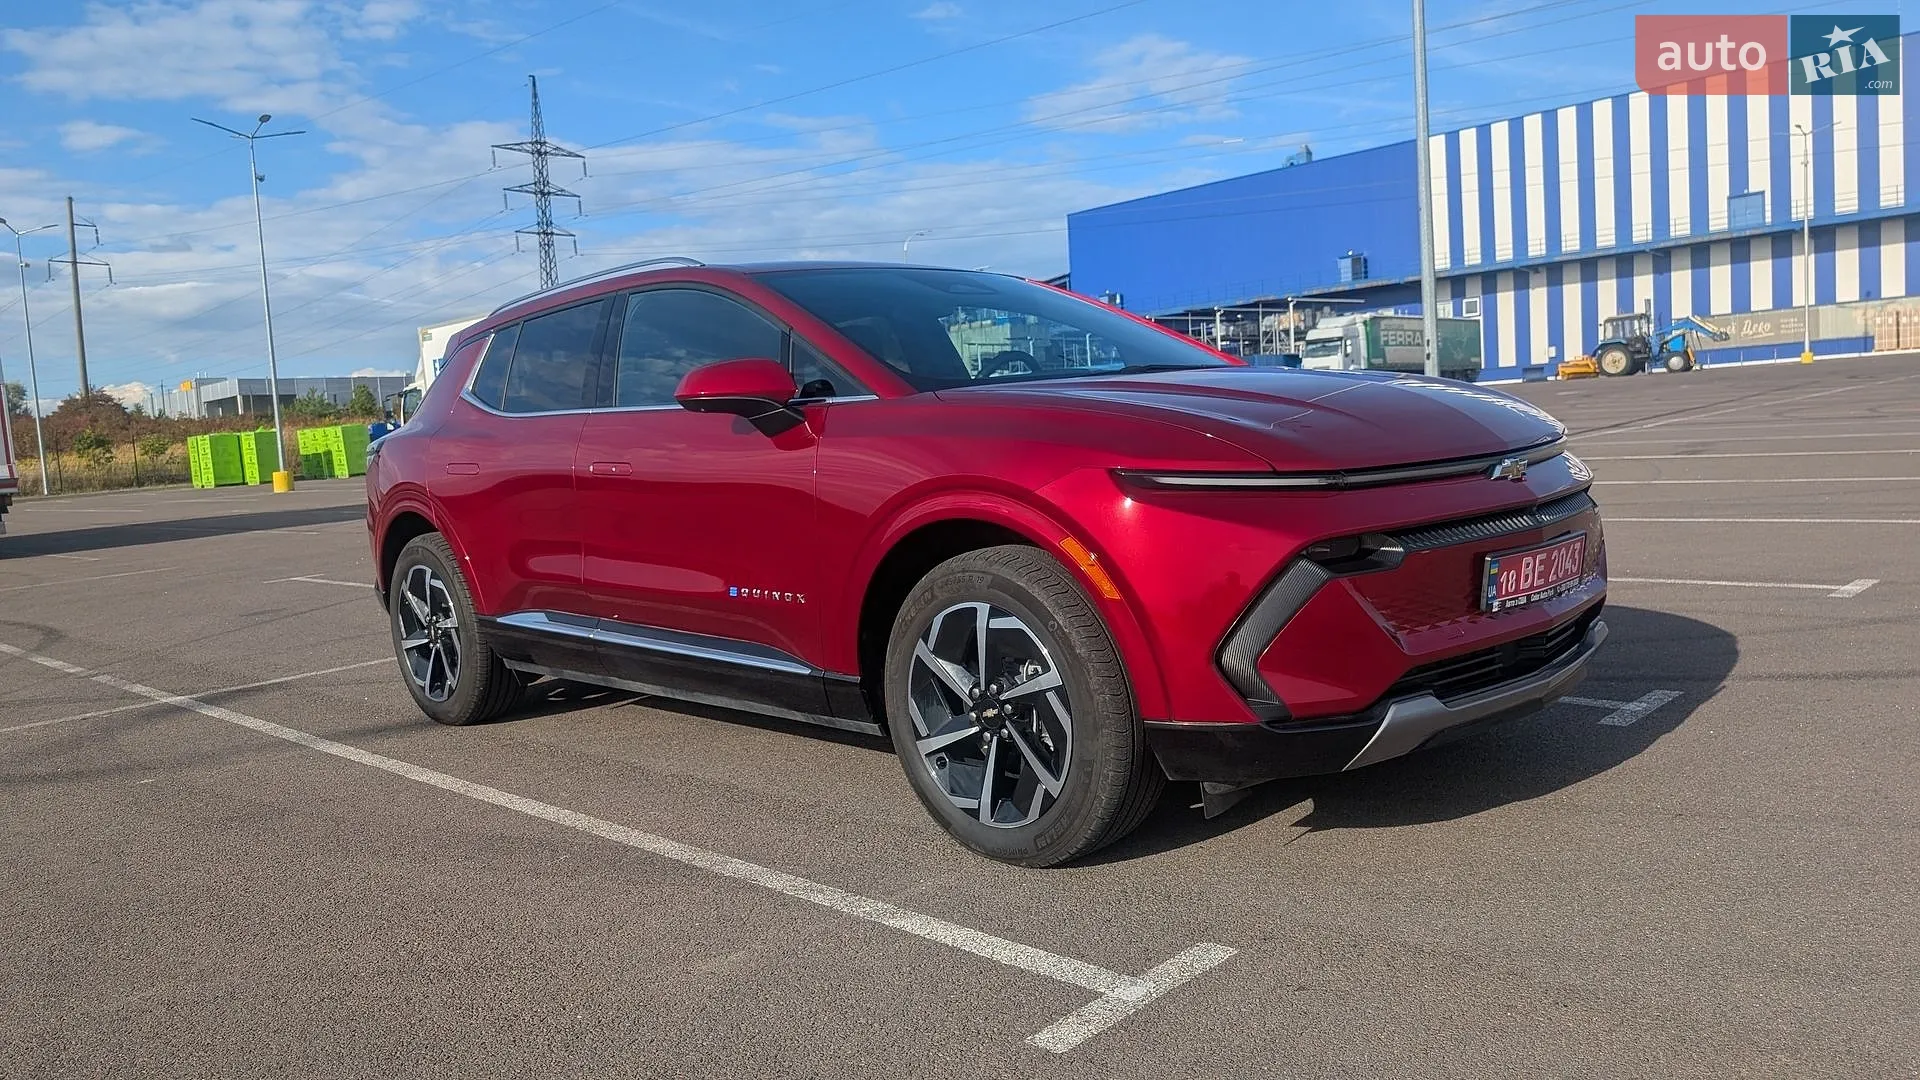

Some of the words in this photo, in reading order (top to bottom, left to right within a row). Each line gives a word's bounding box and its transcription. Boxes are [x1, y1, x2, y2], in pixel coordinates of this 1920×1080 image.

[1380, 330, 1422, 345] FERRA
[1500, 570, 1516, 595] 18
[1520, 553, 1547, 590] BE
[1549, 542, 1581, 583] 2043
[729, 586, 805, 604] EQUINOX
[1488, 585, 1497, 598] UA
